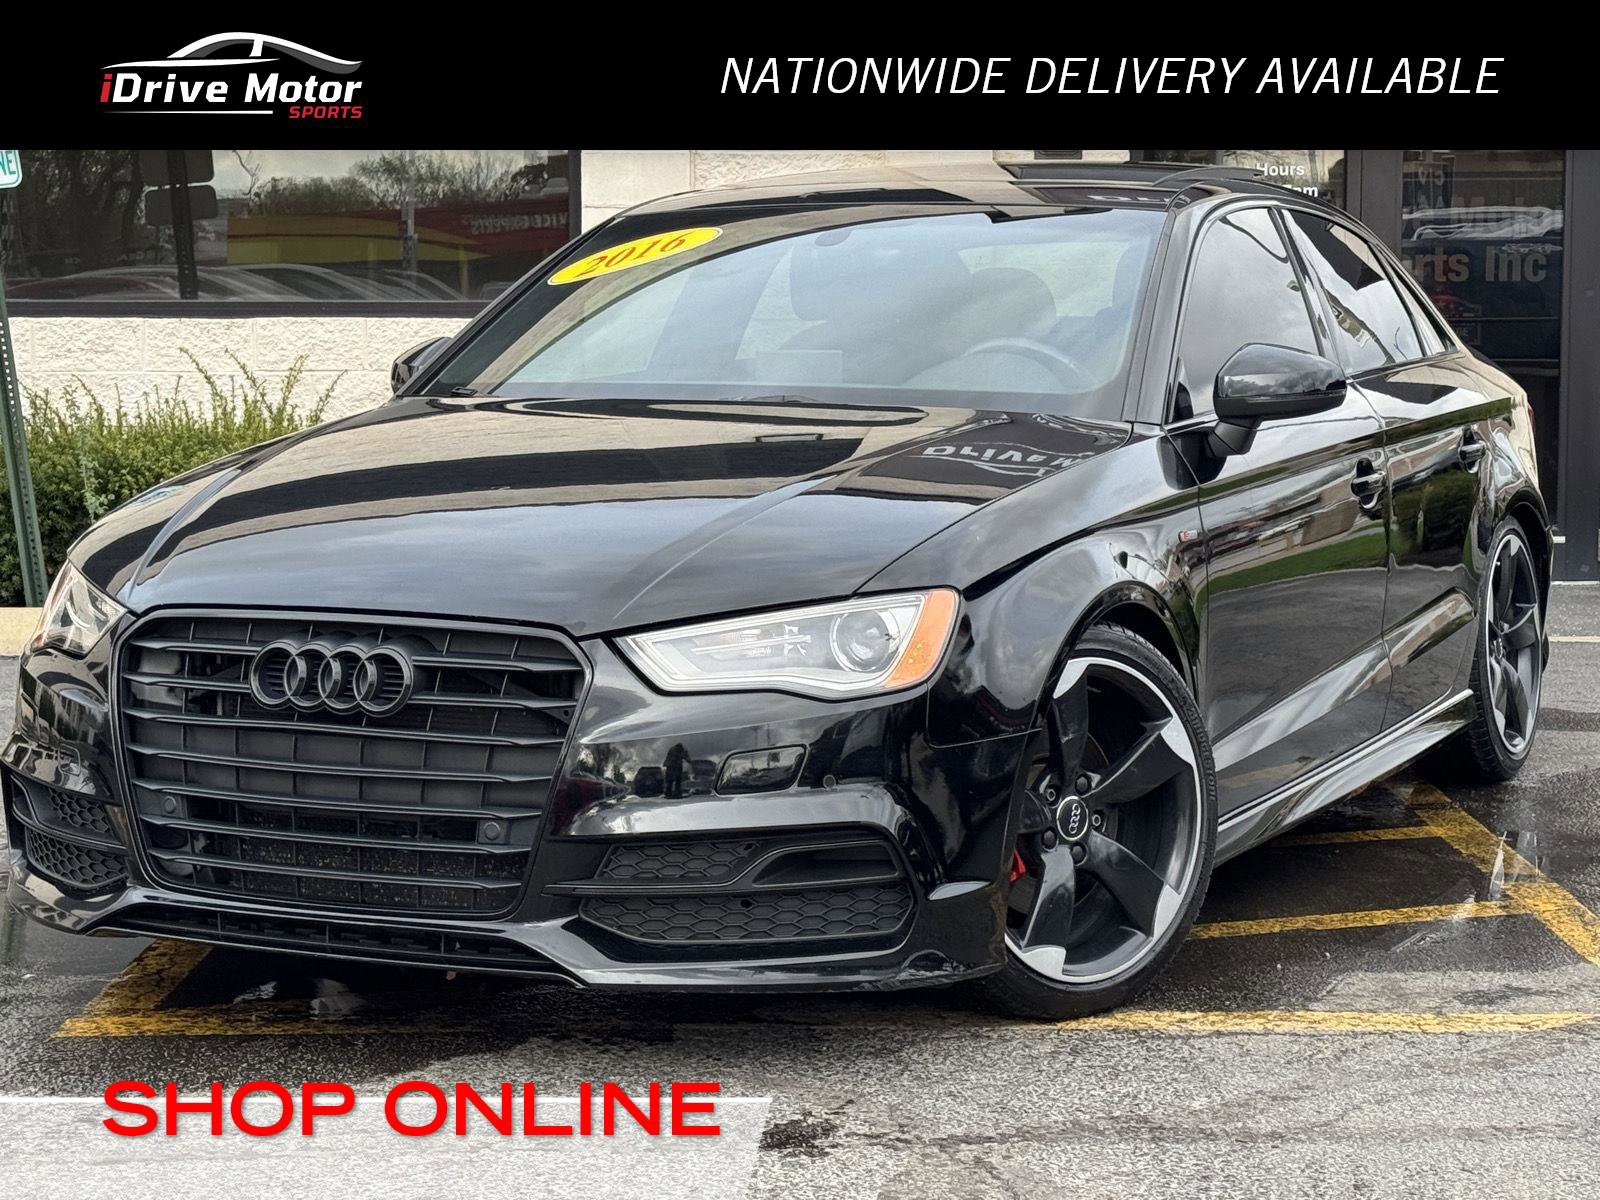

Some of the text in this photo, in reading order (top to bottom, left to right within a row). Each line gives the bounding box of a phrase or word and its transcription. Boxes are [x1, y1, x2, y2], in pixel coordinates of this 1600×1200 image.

[1256, 162, 1305, 176] Hours
[573, 230, 697, 279] 2016
[1485, 246, 1547, 282] Inc
